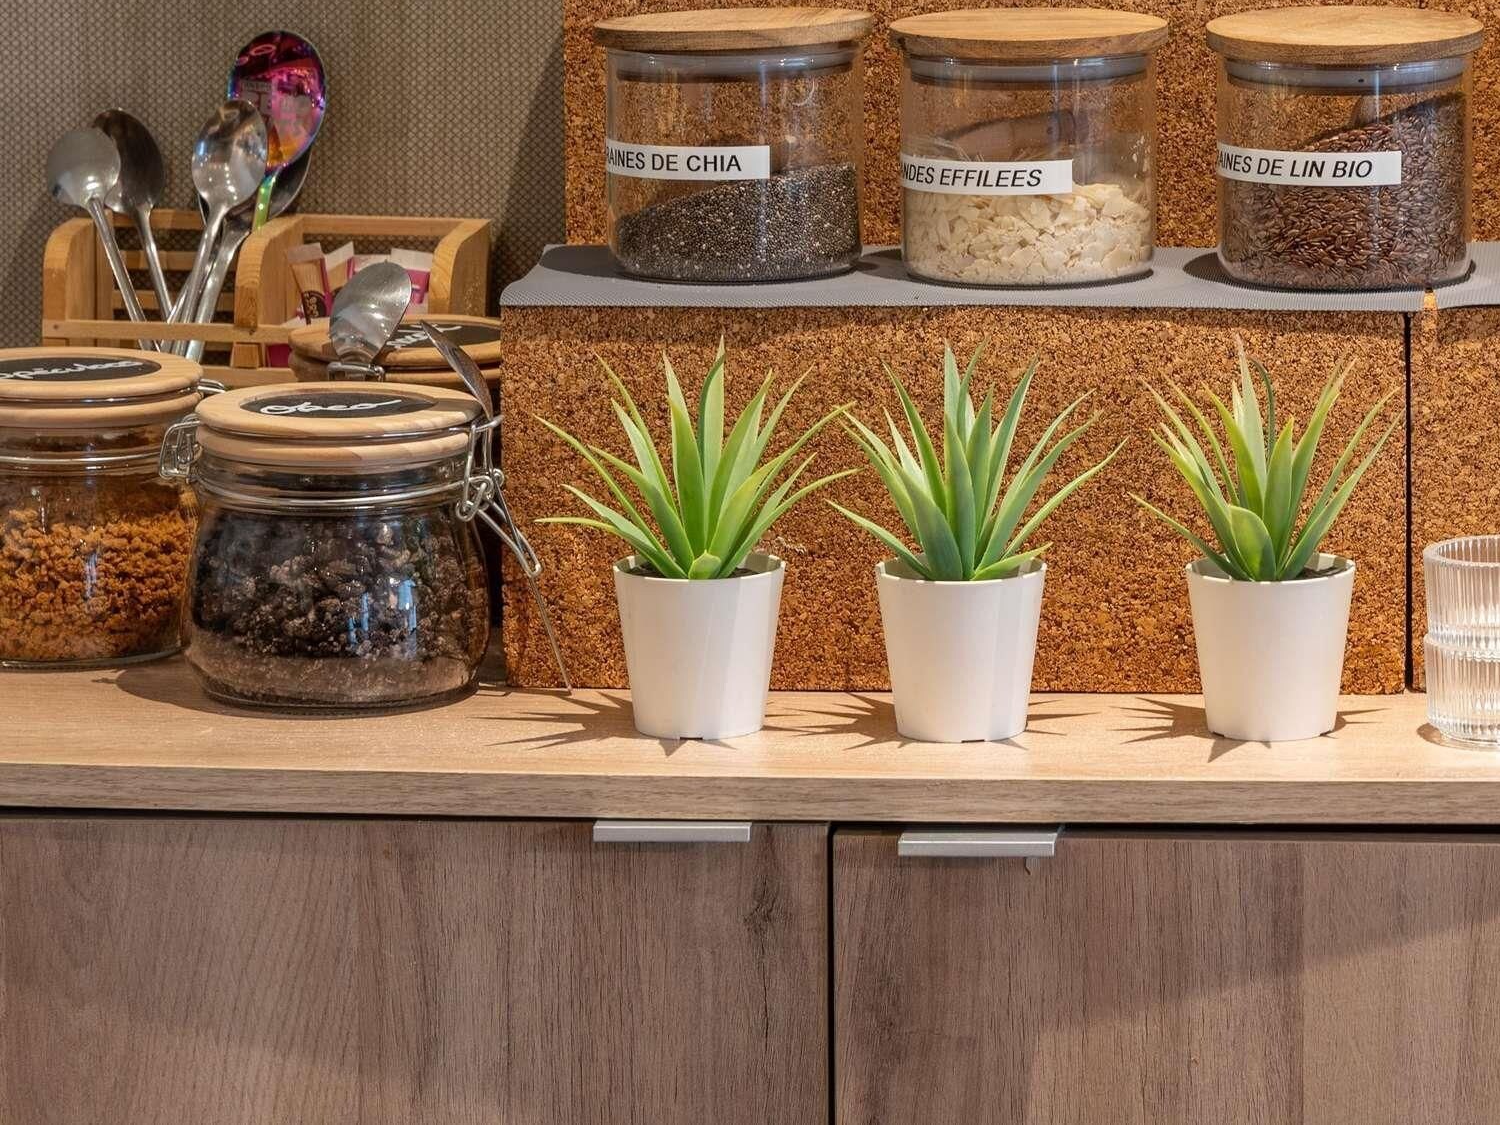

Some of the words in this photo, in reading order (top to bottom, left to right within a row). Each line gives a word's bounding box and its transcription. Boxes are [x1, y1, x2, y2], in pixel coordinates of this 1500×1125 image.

[607, 147, 646, 170] AINES
[651, 153, 679, 172] DE
[686, 154, 742, 172] CHIA
[1217, 150, 1253, 174] AINES
[1256, 157, 1285, 176] DE
[1289, 160, 1327, 178] LIN
[1332, 160, 1373, 178] BIO
[903, 162, 935, 185] NDES
[939, 168, 1043, 187] EFFILEES
